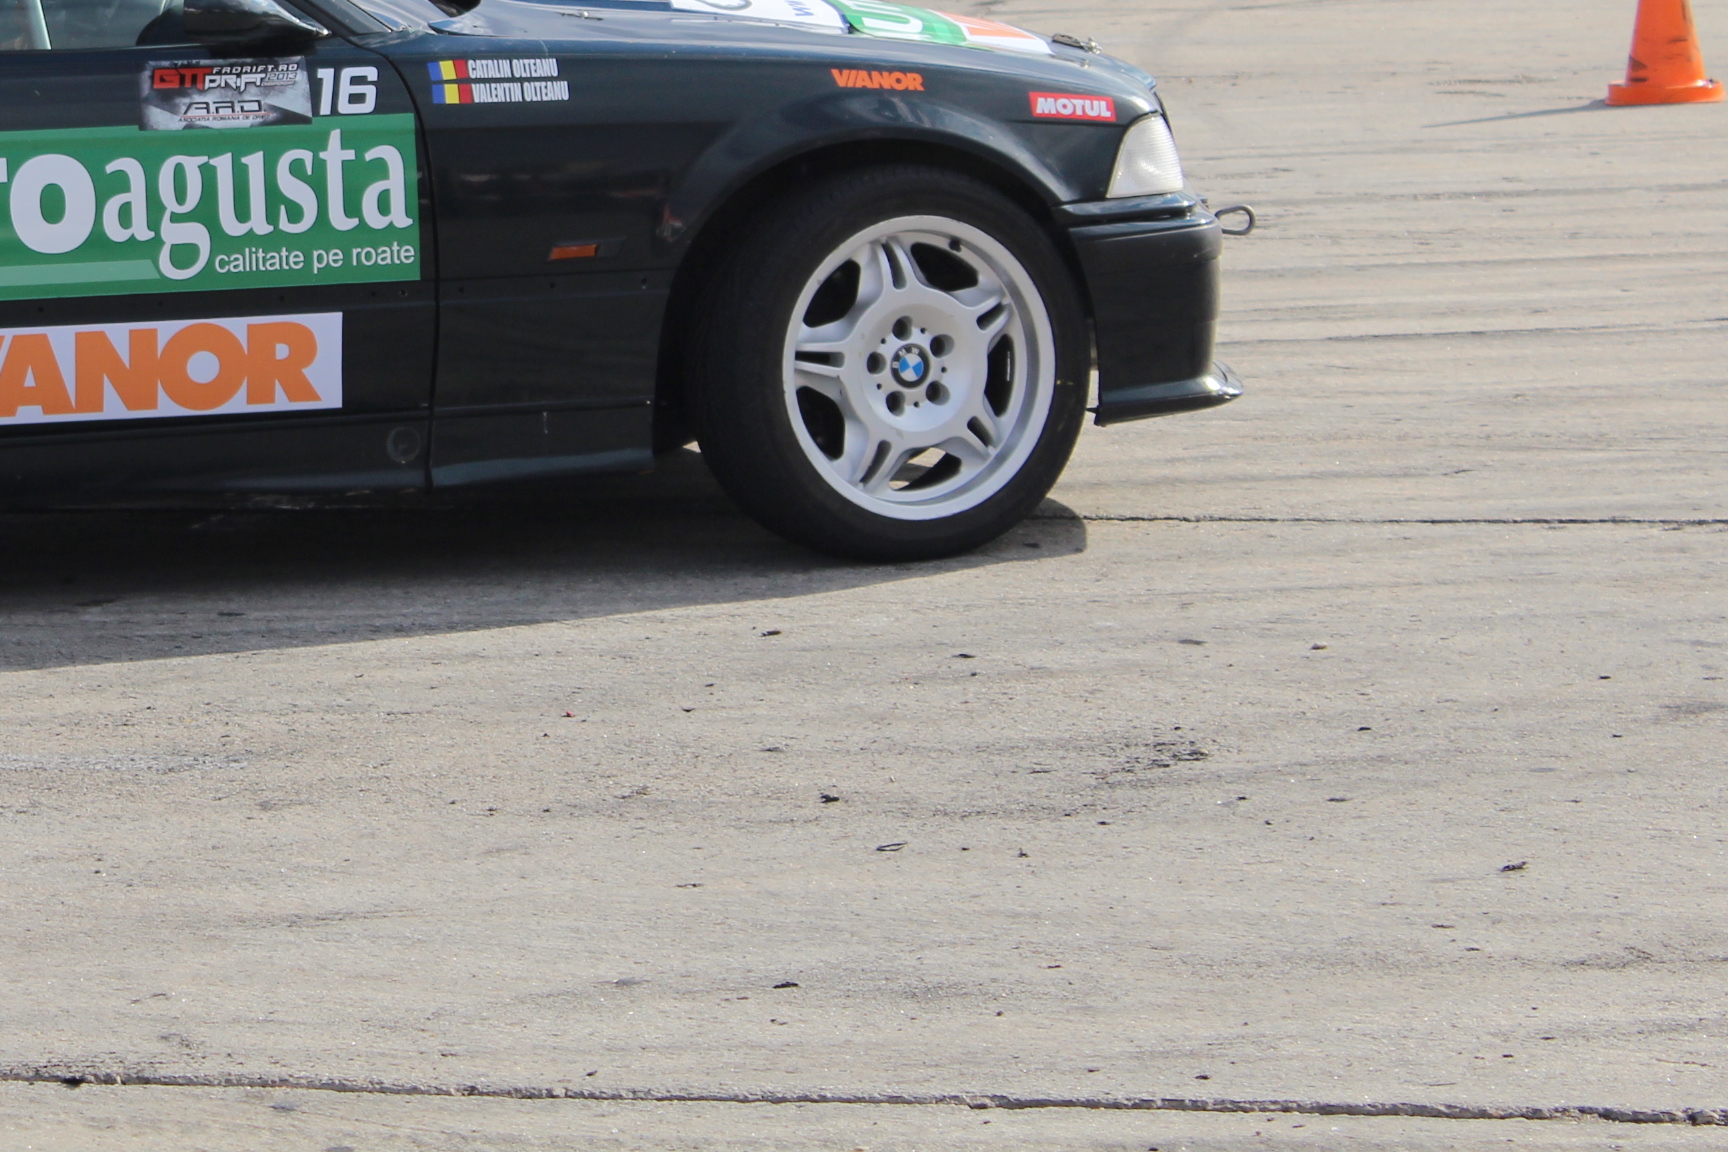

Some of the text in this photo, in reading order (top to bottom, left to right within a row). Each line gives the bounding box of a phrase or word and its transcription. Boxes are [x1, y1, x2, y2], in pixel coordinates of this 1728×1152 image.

[467, 58, 558, 79] CATALIN OLTEANU
[831, 68, 925, 91] VIANOR
[317, 66, 378, 116] 16
[472, 80, 569, 103] VALENTIN OLTEANU
[1036, 97, 1111, 118] MOTUL
[215, 243, 415, 274] calitate pe roate
